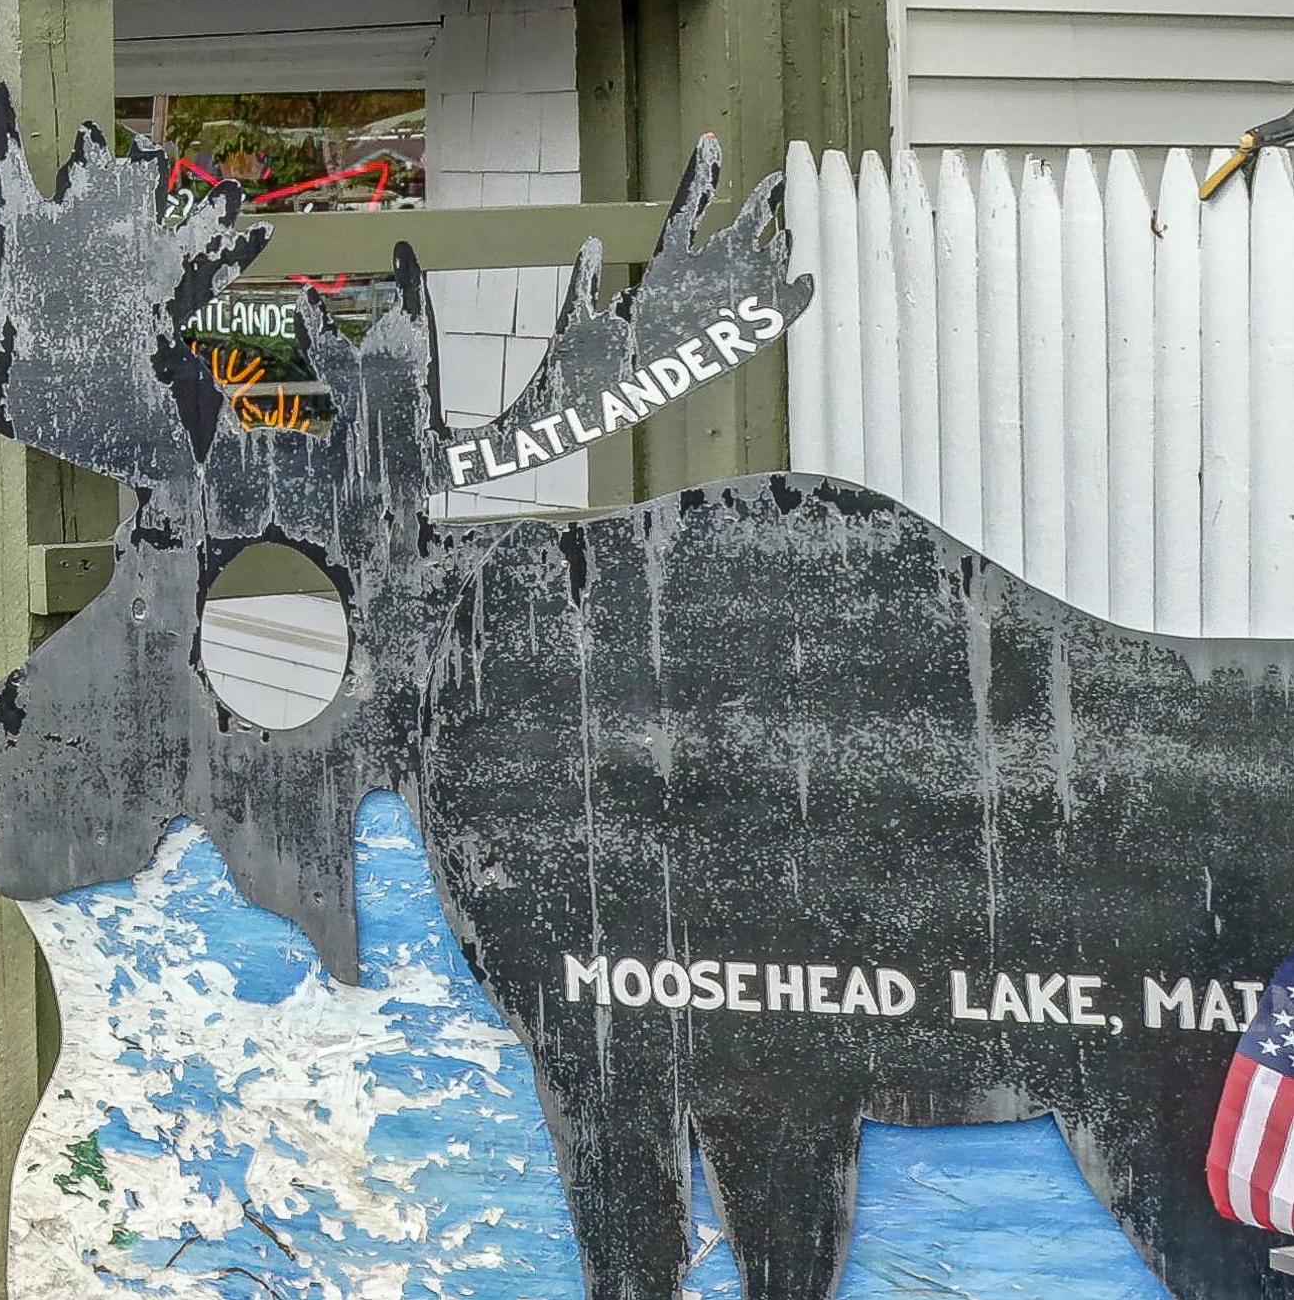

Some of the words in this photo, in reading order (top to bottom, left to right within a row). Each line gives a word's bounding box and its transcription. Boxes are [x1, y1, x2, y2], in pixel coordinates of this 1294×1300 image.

[180, 297, 297, 339] ATLANDE
[445, 296, 785, 486] FLATLANDER'S
[564, 954, 916, 1017] MOOSEHEAD
[949, 969, 1123, 1036] LAKE,
[1143, 976, 1264, 1033] MAI
